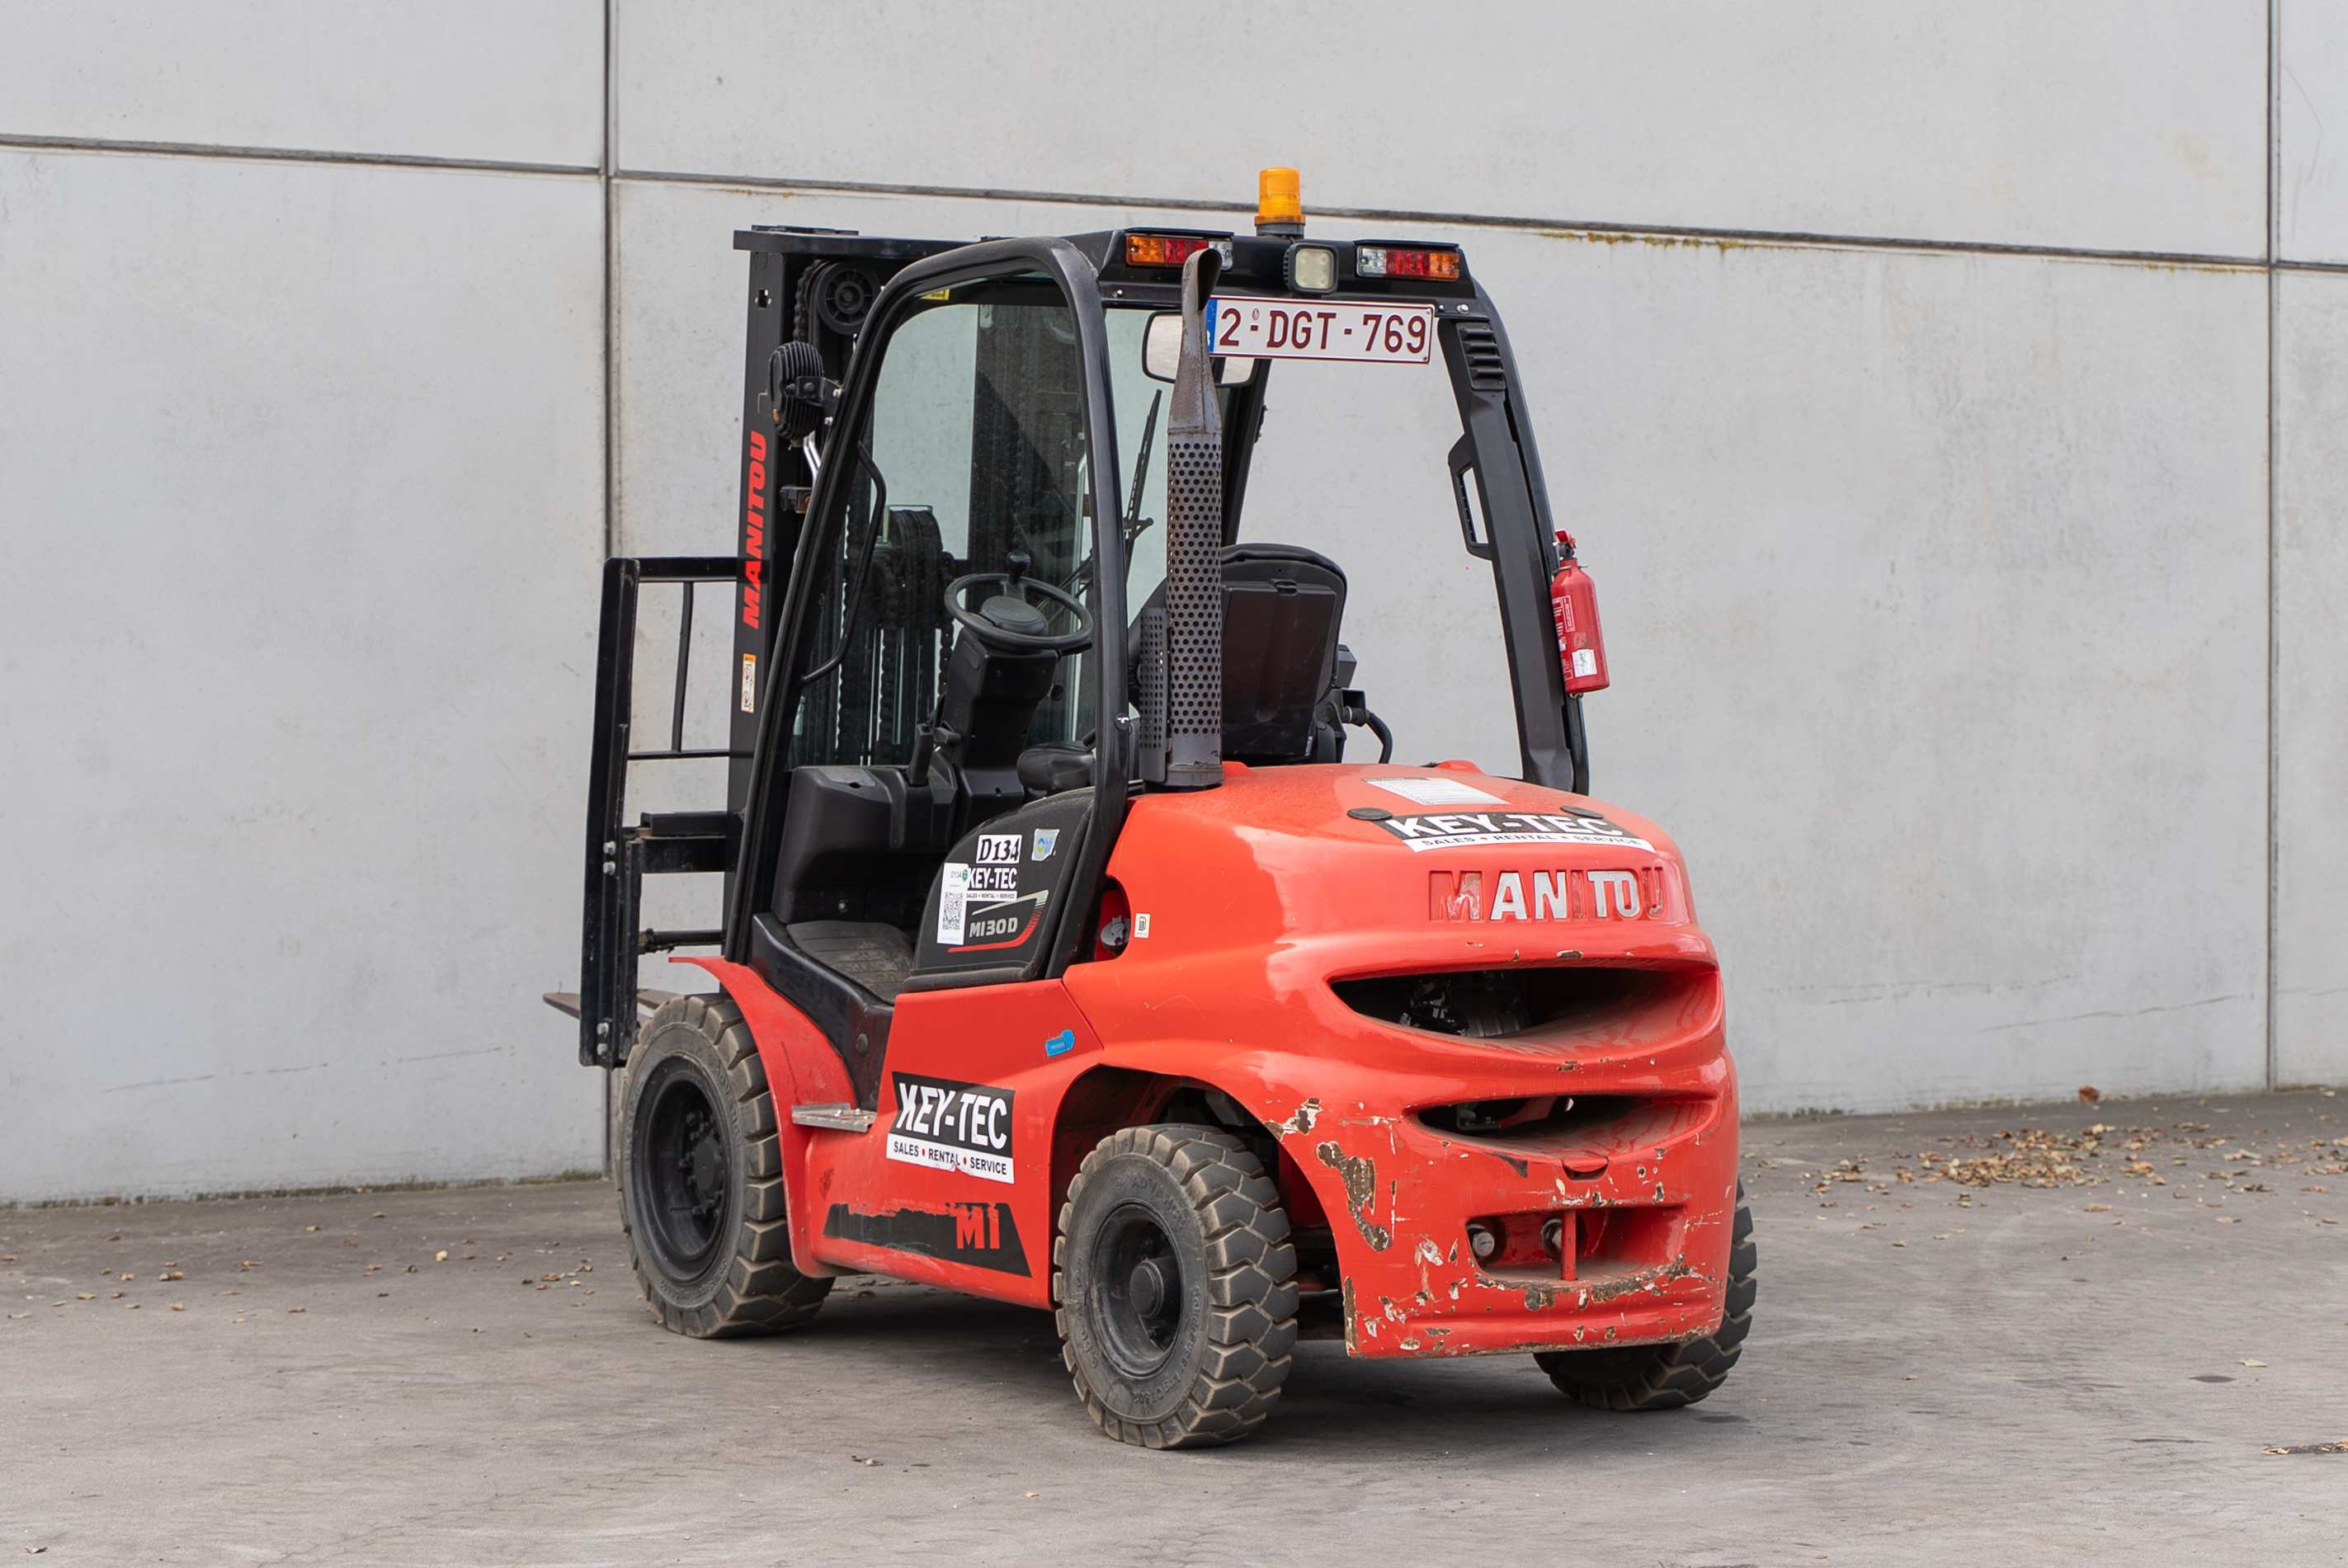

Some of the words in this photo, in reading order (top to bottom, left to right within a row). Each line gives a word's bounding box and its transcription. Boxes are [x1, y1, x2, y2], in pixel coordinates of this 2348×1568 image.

[743, 431, 767, 629] MANITOU
[1385, 813, 1624, 837] KEY-TEC
[978, 838, 1020, 862] D134
[1422, 836, 1476, 846] SALES
[1573, 835, 1643, 845] SERVICE
[969, 867, 1017, 889] KEY-TEC
[895, 1082, 1007, 1150] KEY-TEC
[893, 1142, 919, 1157] SALES
[928, 1149, 961, 1166] RENTAL
[969, 1156, 1007, 1175] SERVICE
